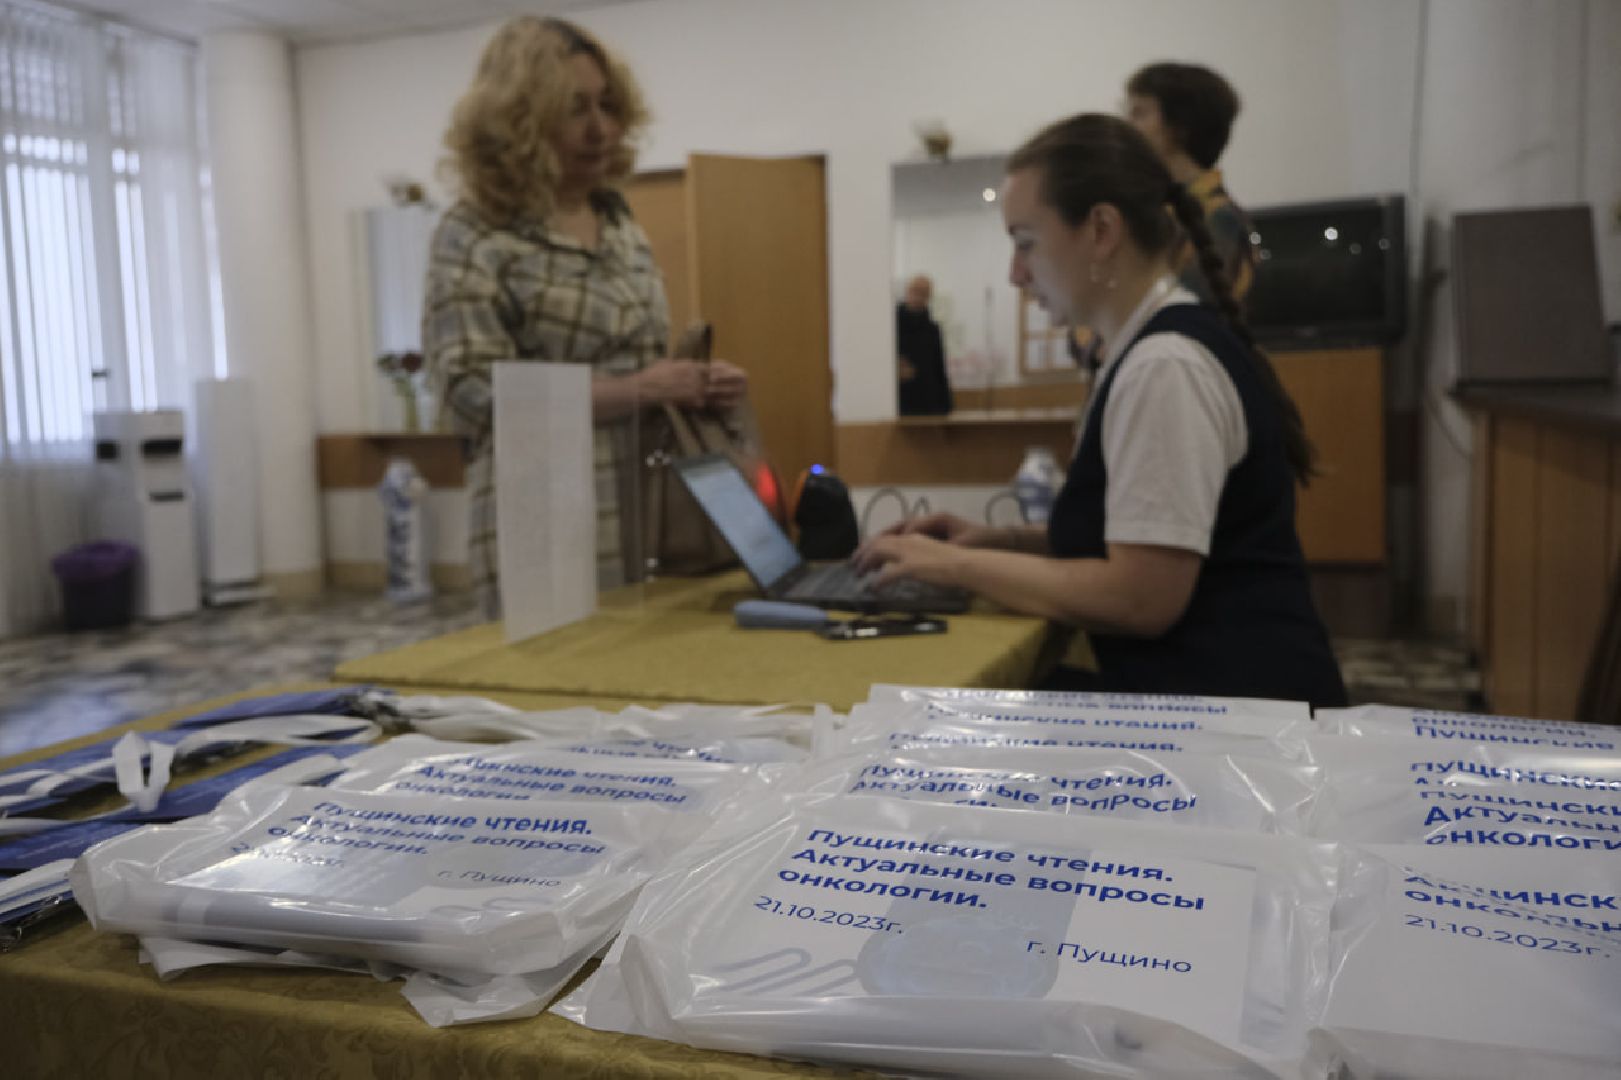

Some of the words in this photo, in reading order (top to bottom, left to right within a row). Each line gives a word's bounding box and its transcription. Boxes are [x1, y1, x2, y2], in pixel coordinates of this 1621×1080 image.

[570, 785, 687, 803] вопросы
[1051, 773, 1173, 791] чтения.
[1051, 795, 1197, 813] вопросы
[485, 815, 592, 835] чтения.
[472, 834, 607, 854] вопросы
[806, 829, 1016, 862] Пущинские
[1027, 853, 1174, 882] чтения.
[778, 869, 988, 908] онкологии.
[791, 848, 1017, 886] Актуальные
[1027, 876, 1205, 911] вопросы
[753, 895, 905, 934] 21.10.2023г.
[1026, 940, 1047, 954] г.
[1056, 942, 1193, 973] Пущино
